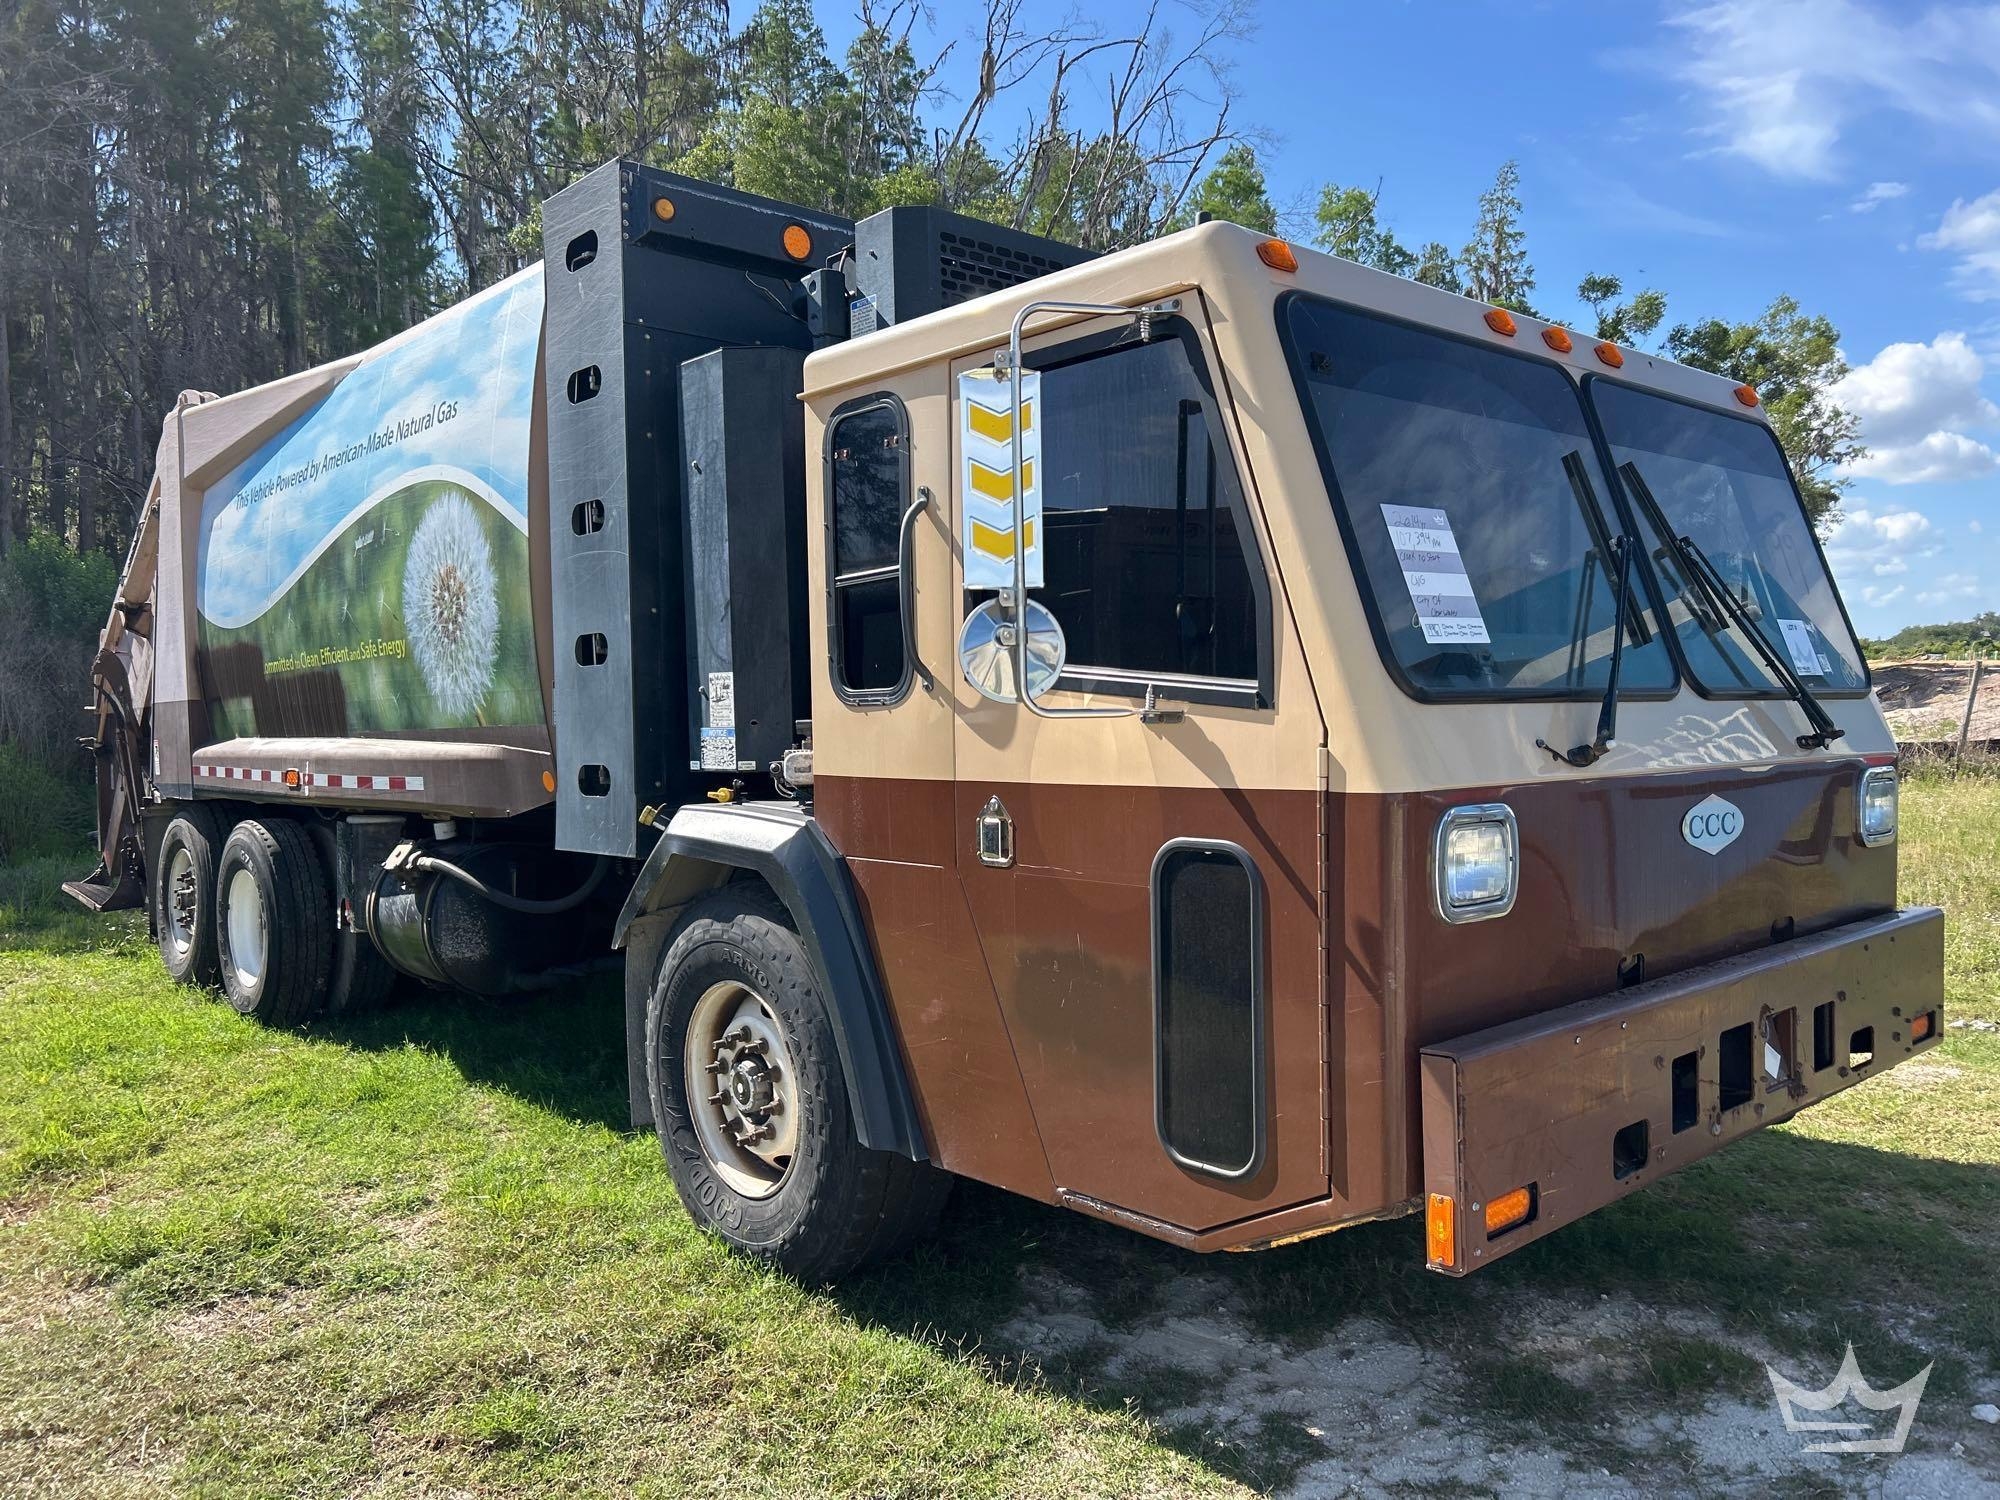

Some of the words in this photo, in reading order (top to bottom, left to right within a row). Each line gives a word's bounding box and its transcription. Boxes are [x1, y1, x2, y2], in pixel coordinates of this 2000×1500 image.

[236, 489, 250, 511] This
[250, 481, 275, 505] Vehicle
[275, 464, 310, 493] Powered
[309, 460, 322, 482] by
[321, 425, 394, 473] American-Made
[395, 405, 435, 442] Natural
[437, 400, 459, 425] Gas
[264, 653, 294, 675] ommitted
[321, 646, 350, 666] Efficient
[350, 647, 361, 661] and
[361, 639, 378, 659] Safe
[378, 638, 406, 659] Energy
[1689, 812, 1736, 839] CCC
